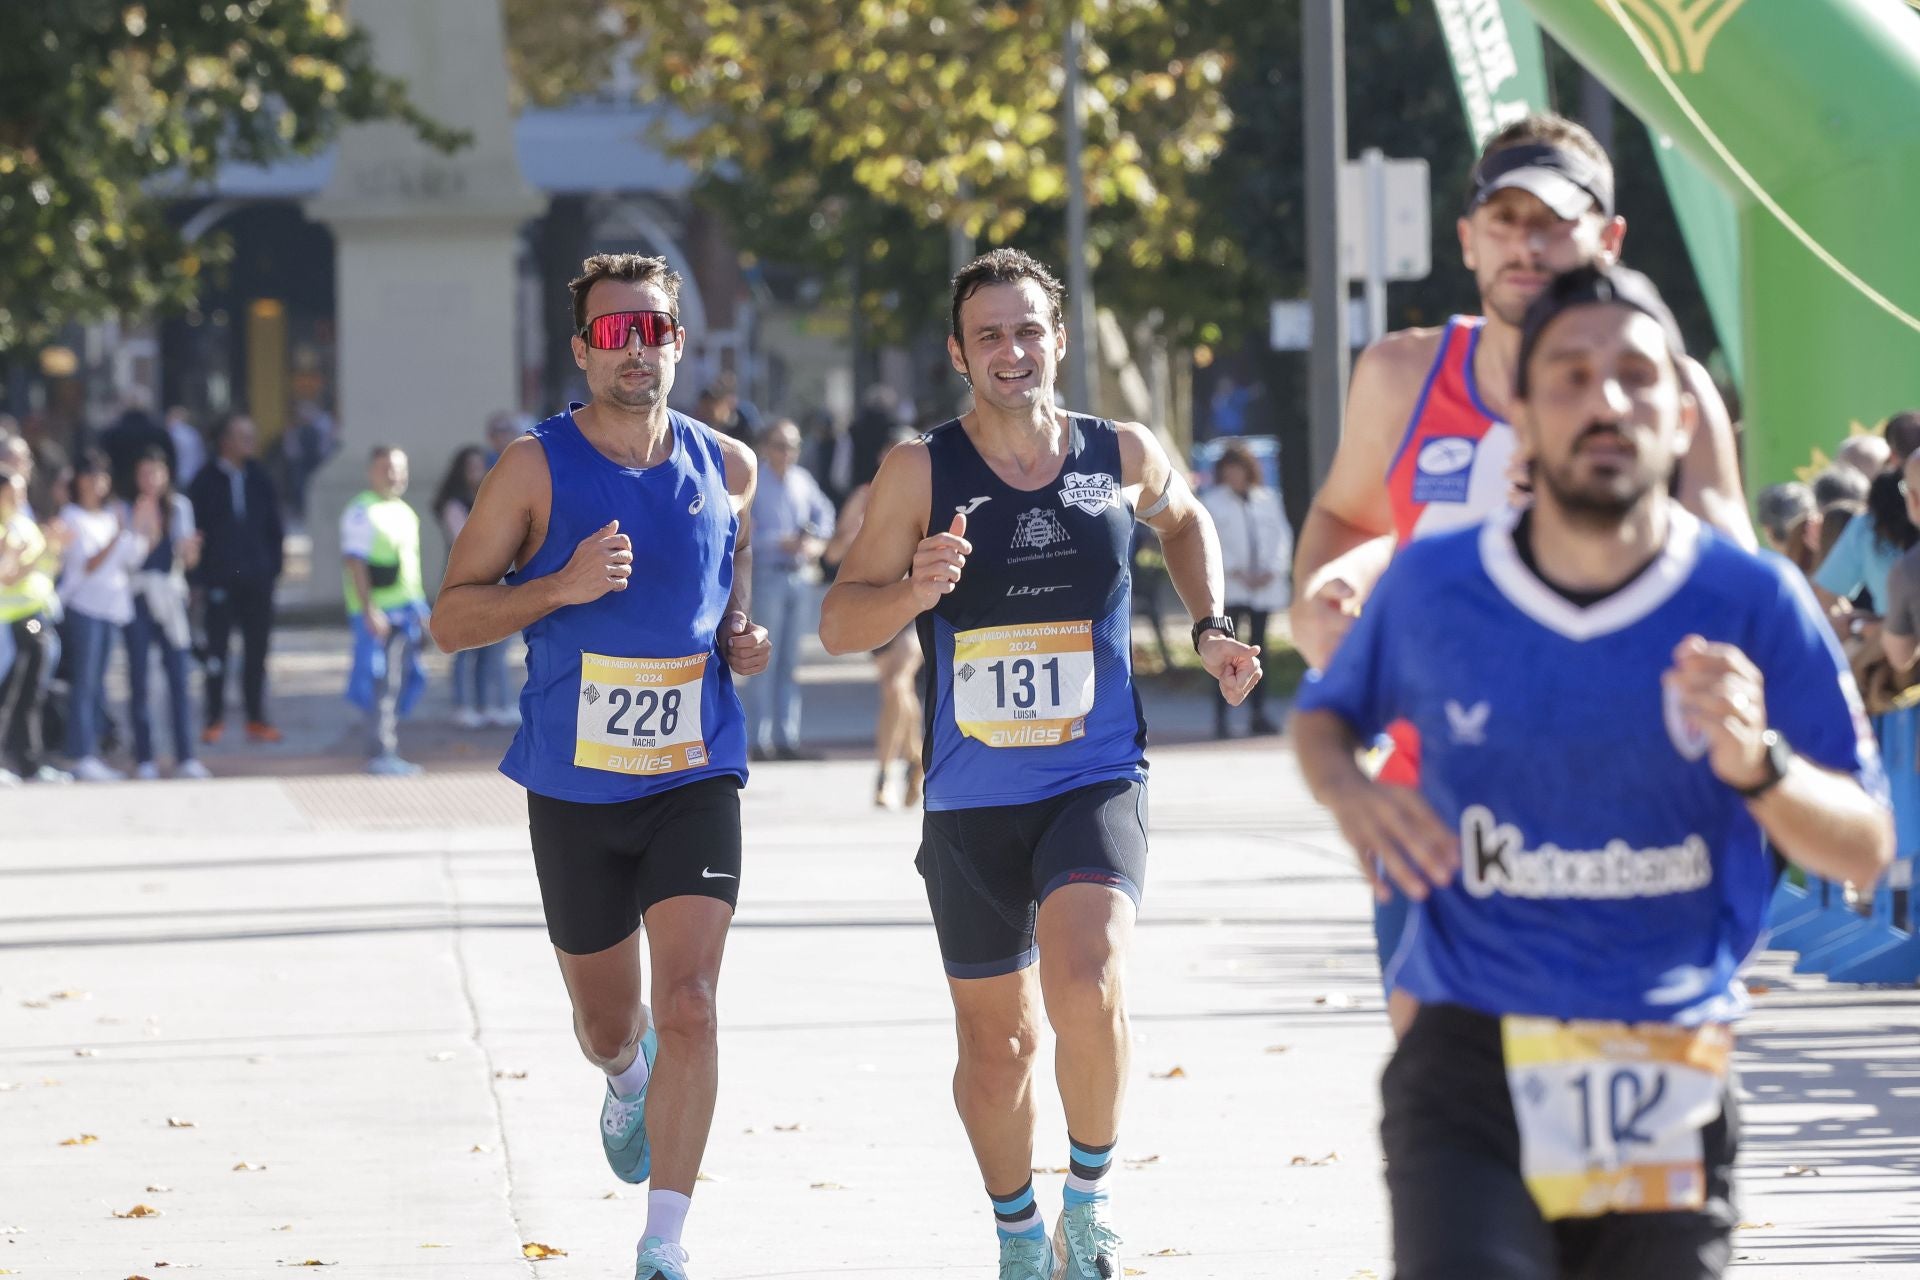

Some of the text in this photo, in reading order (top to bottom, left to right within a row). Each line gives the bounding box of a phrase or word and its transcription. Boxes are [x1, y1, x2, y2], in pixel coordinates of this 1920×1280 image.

[1069, 489, 1114, 500] VETUSTA
[1007, 552, 1045, 564] Universidad
[1054, 547, 1077, 557] Oviedo
[983, 630, 1012, 641] MEDIA
[1012, 625, 1058, 639] MARATÓN
[1059, 623, 1090, 635] AVILÉS
[1008, 641, 1037, 652] 2024
[610, 659, 639, 669] MEDIA
[640, 659, 683, 670] MARATÓN
[634, 673, 664, 683] 2024
[987, 657, 1060, 709] 131
[606, 688, 682, 737] 228
[1013, 709, 1037, 719] LUISIN
[631, 737, 656, 748] NACHO
